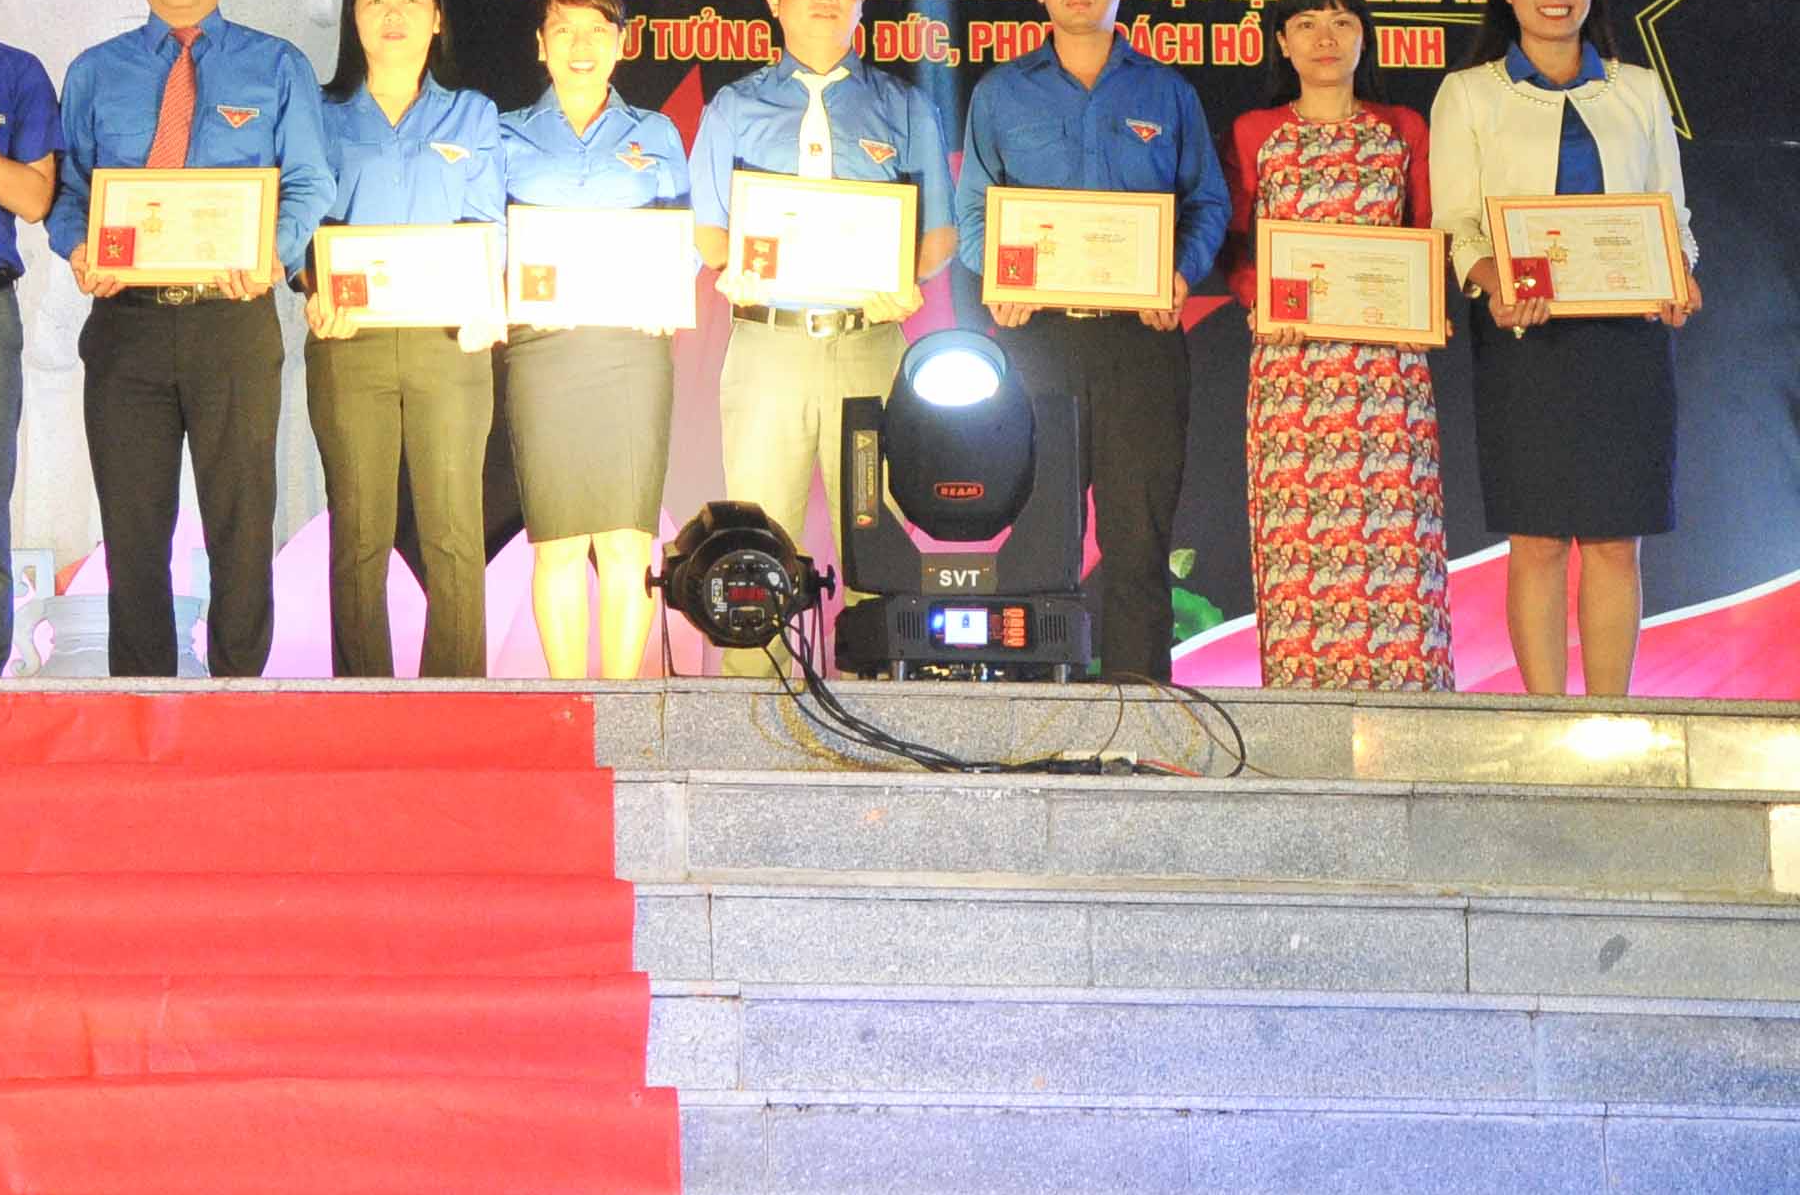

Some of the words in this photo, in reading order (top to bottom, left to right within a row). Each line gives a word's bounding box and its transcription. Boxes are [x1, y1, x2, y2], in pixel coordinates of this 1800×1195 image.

[649, 7, 782, 66] TƯỞNG,
[873, 12, 960, 66] ĐỨC,
[1114, 15, 1203, 65] ÁCH
[1212, 12, 1264, 66] HỒ
[1374, 26, 1446, 68] INH
[939, 569, 980, 587] SVT
